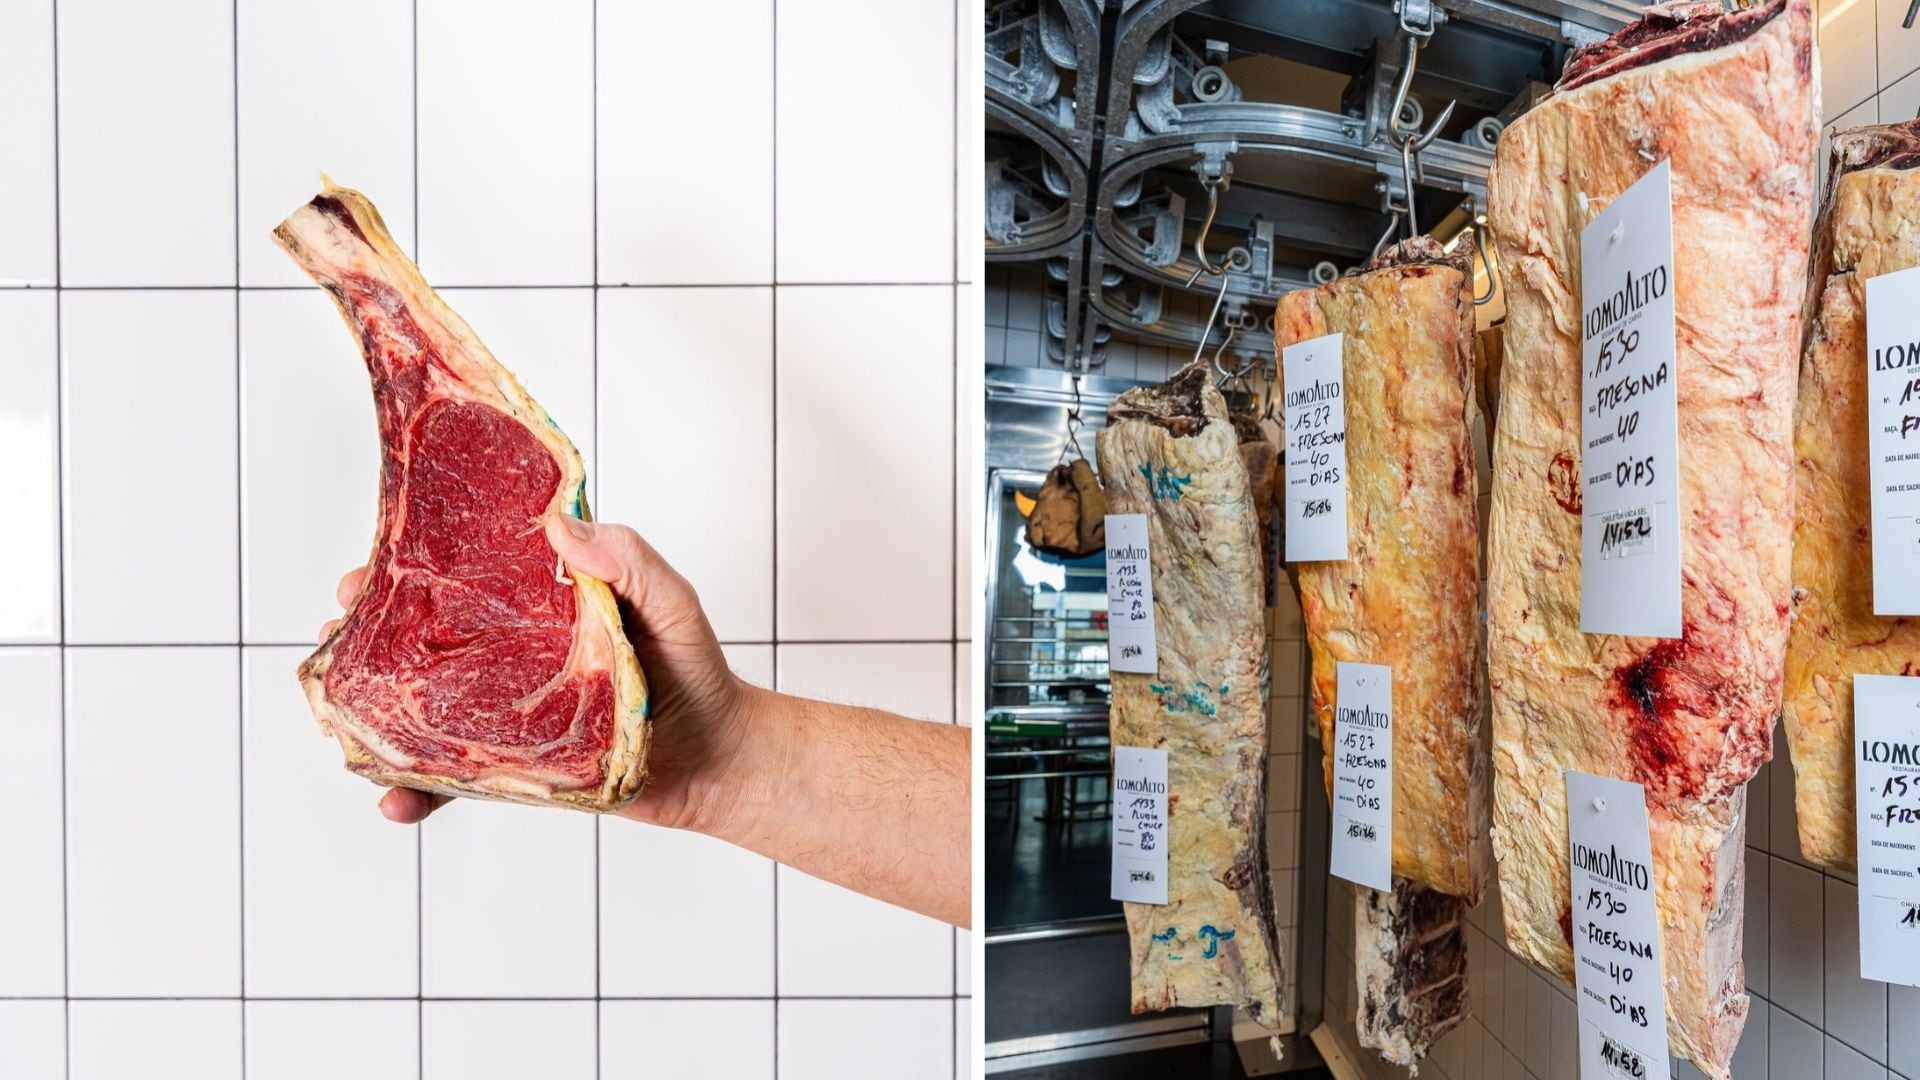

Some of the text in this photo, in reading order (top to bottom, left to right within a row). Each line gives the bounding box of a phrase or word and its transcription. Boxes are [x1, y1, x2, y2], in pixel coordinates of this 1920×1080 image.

[1586, 265, 1667, 341] LOMOALTO
[1595, 329, 1640, 379] 1530
[1287, 379, 1340, 408] LOMOALTO
[1294, 405, 1330, 431] 1527
[1617, 411, 1639, 443] 40
[1310, 450, 1329, 470] 40
[1108, 544, 1147, 560] LOMOALTO
[1338, 704, 1389, 730] LOMOALTO
[1344, 733, 1375, 751] 1527
[1117, 776, 1165, 794] LOMOALTO
[1357, 775, 1375, 792] 40
[1129, 798, 1156, 810] 1933
[1573, 842, 1648, 891] LOMOALTO
[1586, 887, 1627, 916] 1530
[1610, 961, 1633, 985] 40
